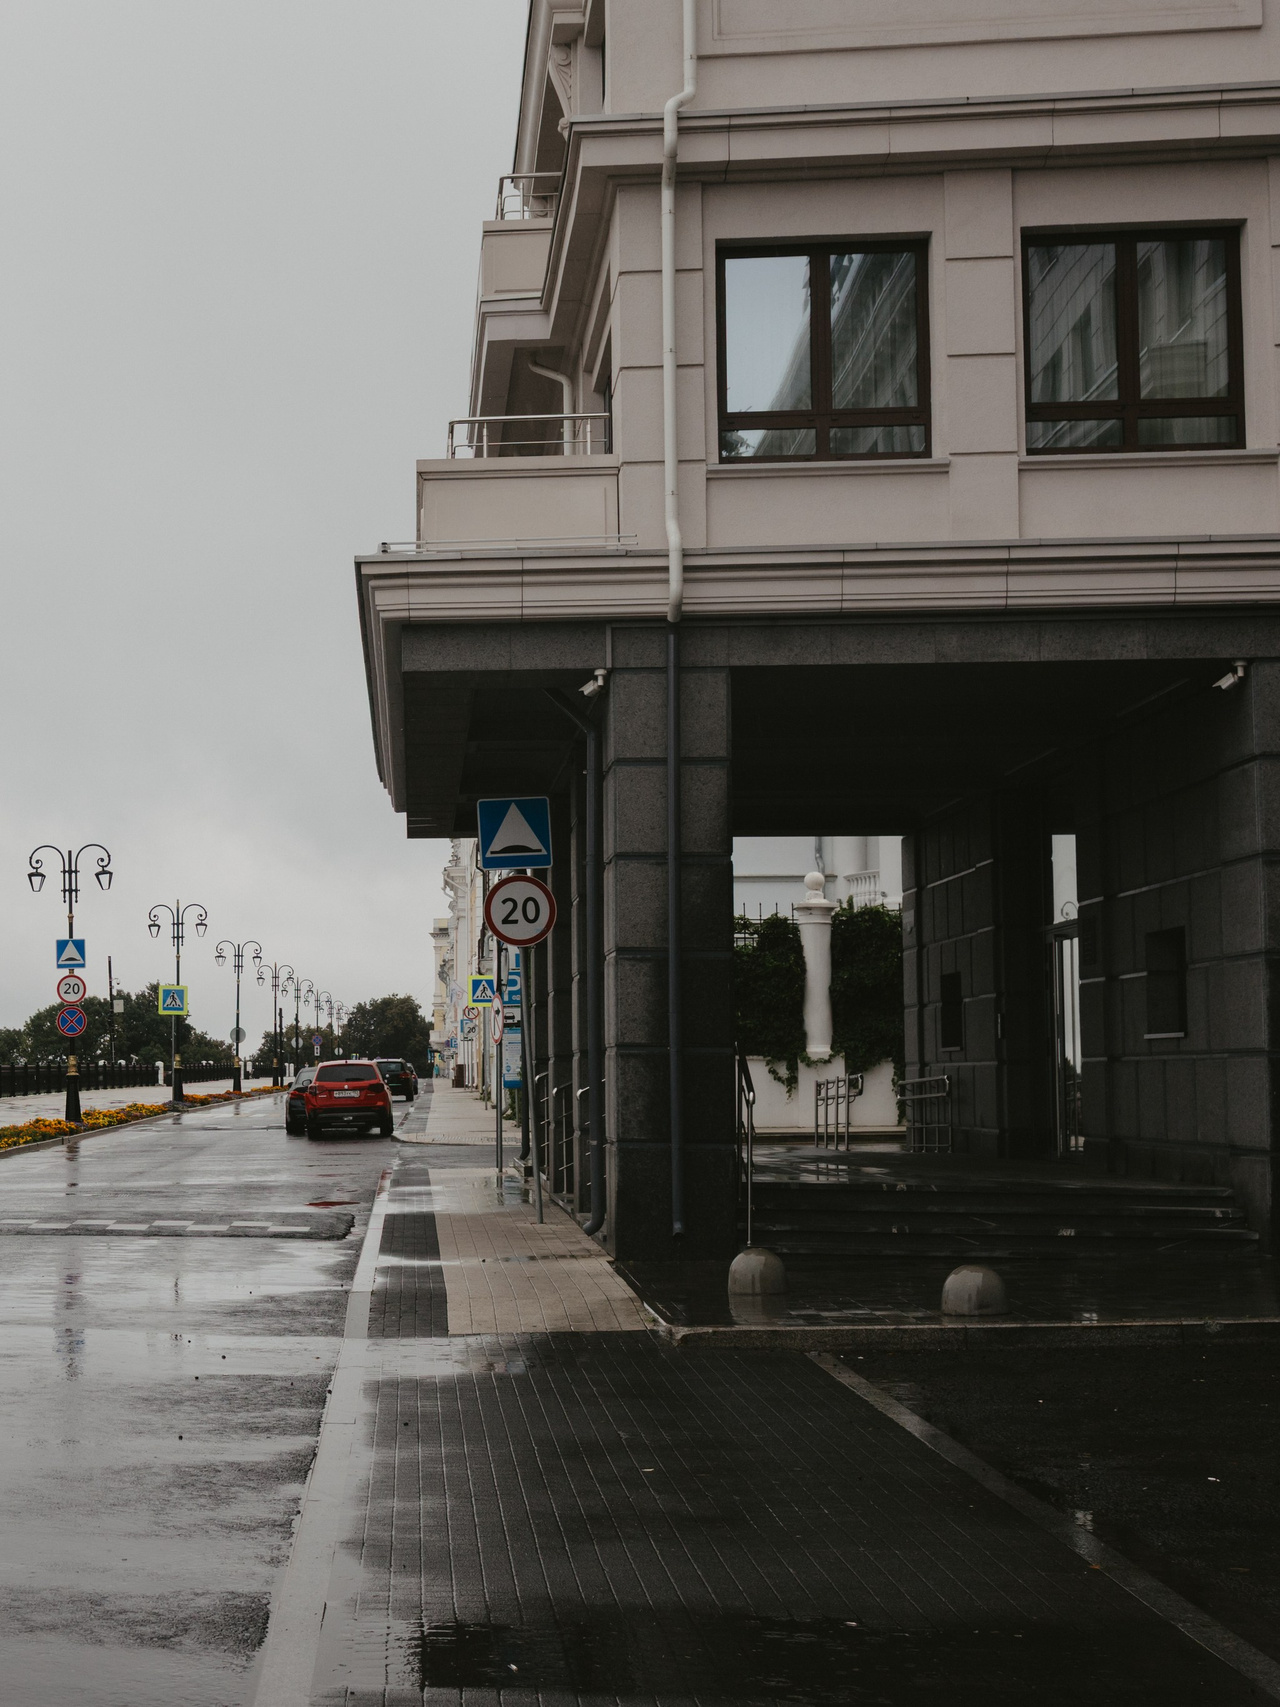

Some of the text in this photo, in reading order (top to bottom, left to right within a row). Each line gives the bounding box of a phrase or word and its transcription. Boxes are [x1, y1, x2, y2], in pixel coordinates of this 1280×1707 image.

[501, 896, 540, 924] 20
[64, 982, 80, 995] 20
[467, 1026, 476, 1034] 20
